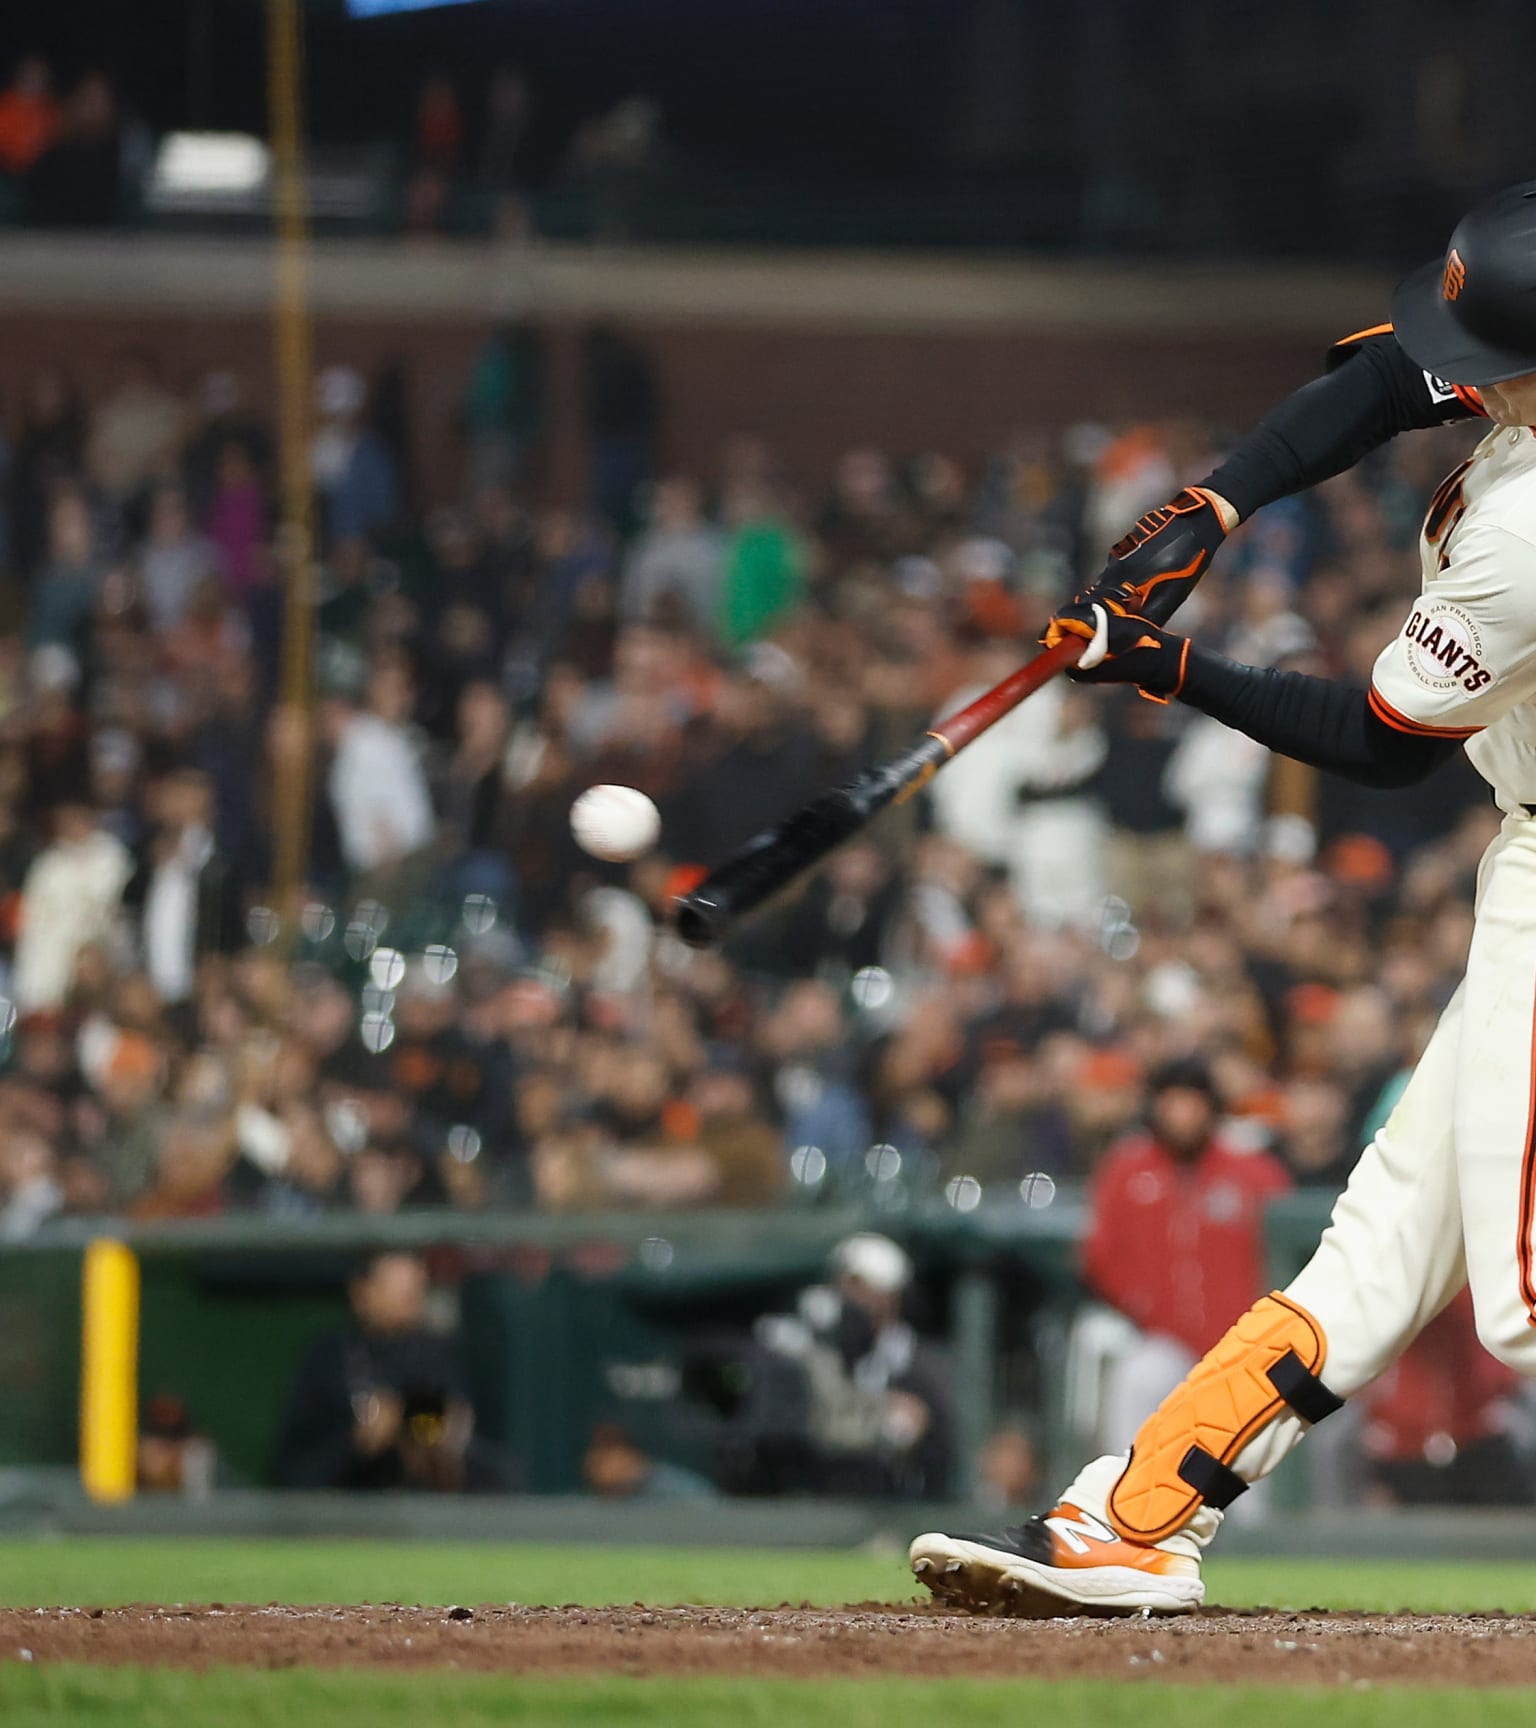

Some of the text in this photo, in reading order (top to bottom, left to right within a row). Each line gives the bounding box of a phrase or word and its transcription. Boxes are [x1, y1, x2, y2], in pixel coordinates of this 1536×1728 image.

[1405, 611, 1492, 692] GIANTS
[1430, 605, 1482, 657] SAN FRANCISCO
[1407, 642, 1457, 689] BASEBALL CLUB
